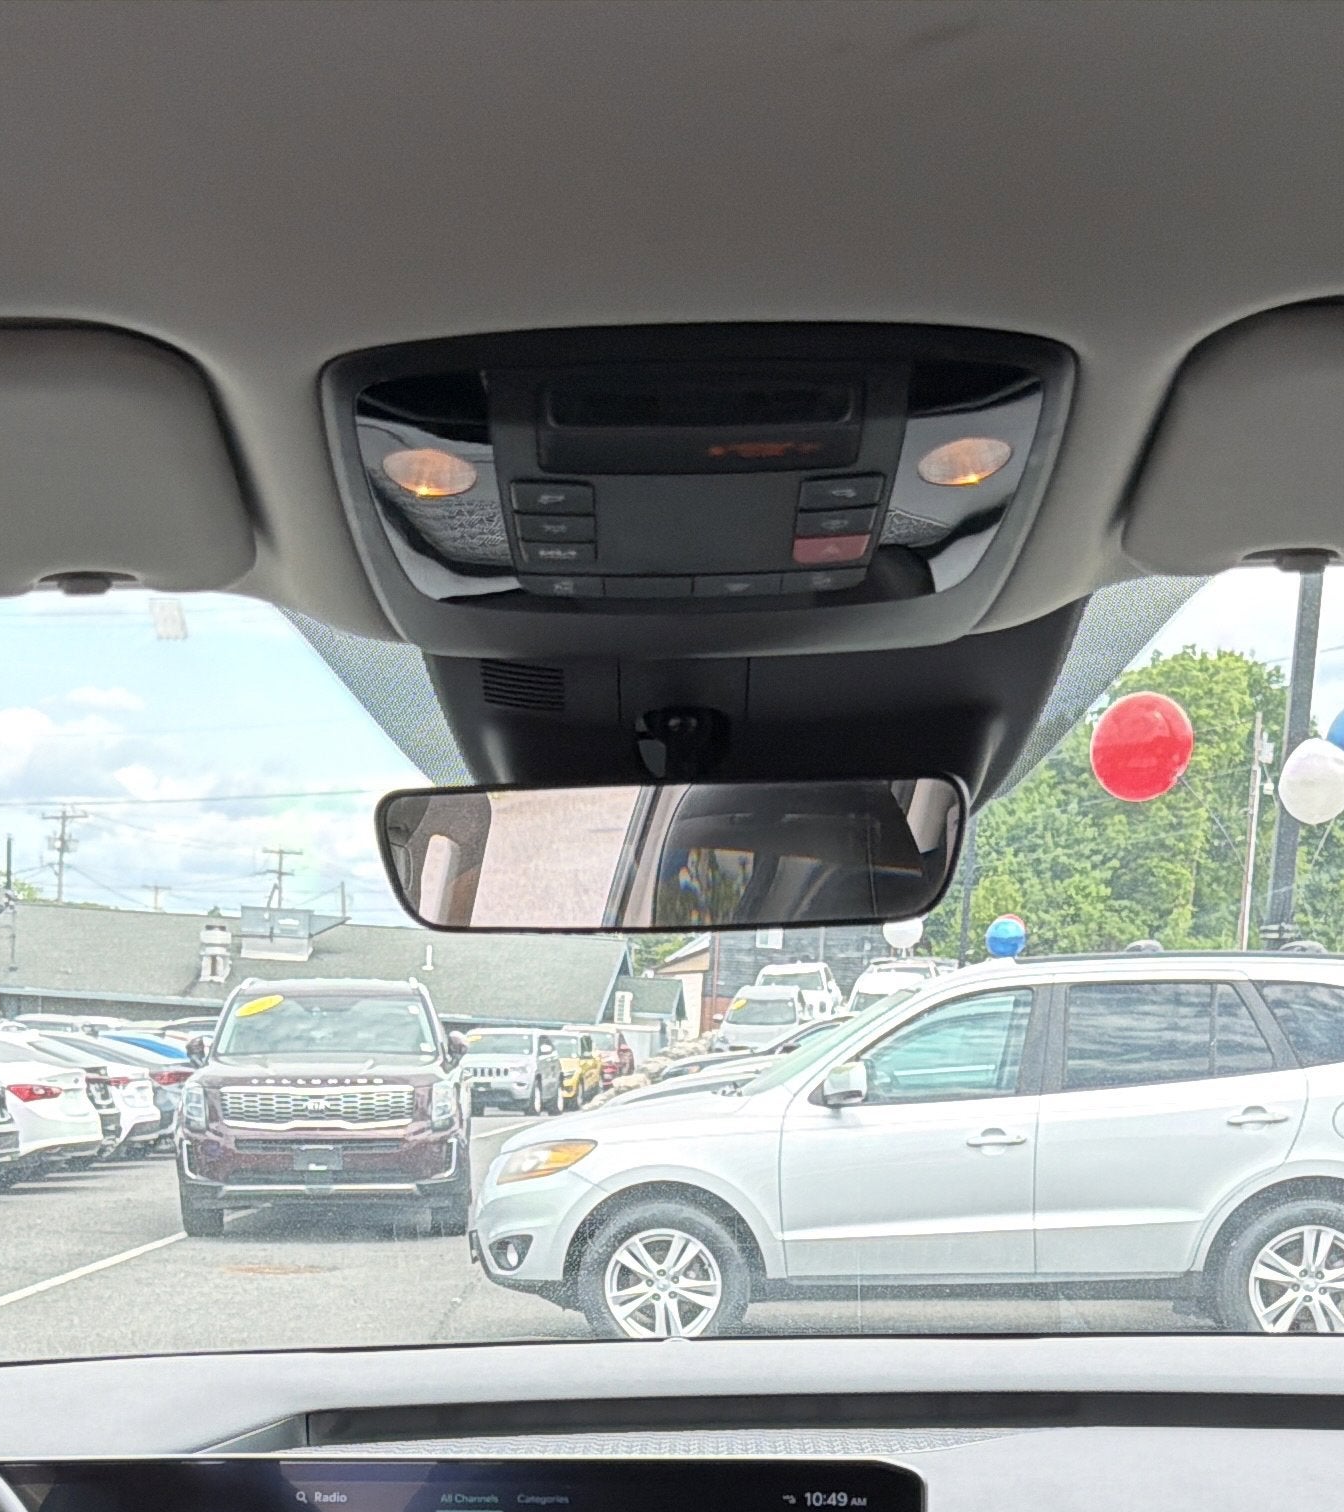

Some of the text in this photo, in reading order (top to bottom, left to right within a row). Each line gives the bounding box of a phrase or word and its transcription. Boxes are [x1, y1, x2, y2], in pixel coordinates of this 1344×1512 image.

[314, 1492, 347, 1503] Radio
[440, 1494, 499, 1504] All Channels
[517, 1494, 569, 1505] Categories
[804, 1492, 867, 1506] 10:49 AM
